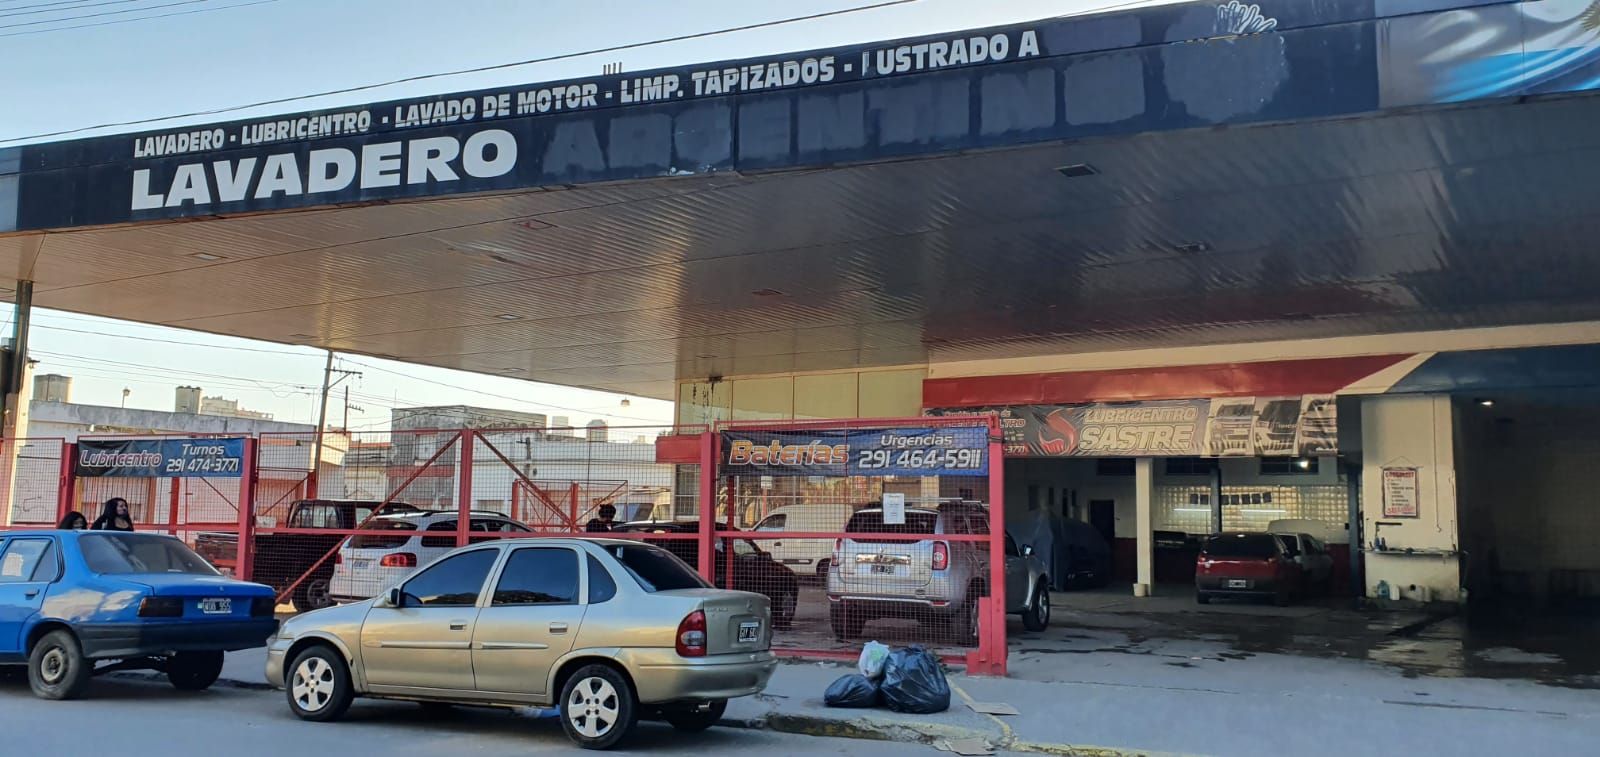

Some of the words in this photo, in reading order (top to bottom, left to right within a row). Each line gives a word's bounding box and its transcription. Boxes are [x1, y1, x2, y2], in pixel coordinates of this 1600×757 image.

[134, 128, 225, 158] LAVADERO
[241, 110, 371, 145] LUBRICENTRO
[395, 97, 476, 128] LAVADO
[483, 95, 510, 117] DE
[517, 83, 598, 115] MOTOR
[620, 75, 683, 104] LIMP.
[691, 56, 836, 97] TAPIZADOS
[1018, 31, 1040, 58] A
[131, 130, 518, 211] LAVADERO
[881, 434, 953, 448] Urgencias
[1079, 423, 1197, 452] SASTRE
[79, 450, 163, 468] Lubricentro
[182, 443, 225, 455] Turnos
[728, 439, 850, 467] Baterías
[858, 450, 891, 469] 291
[896, 448, 983, 469] 464-5911
[166, 459, 184, 473] 291
[187, 457, 239, 472] 474-3771
